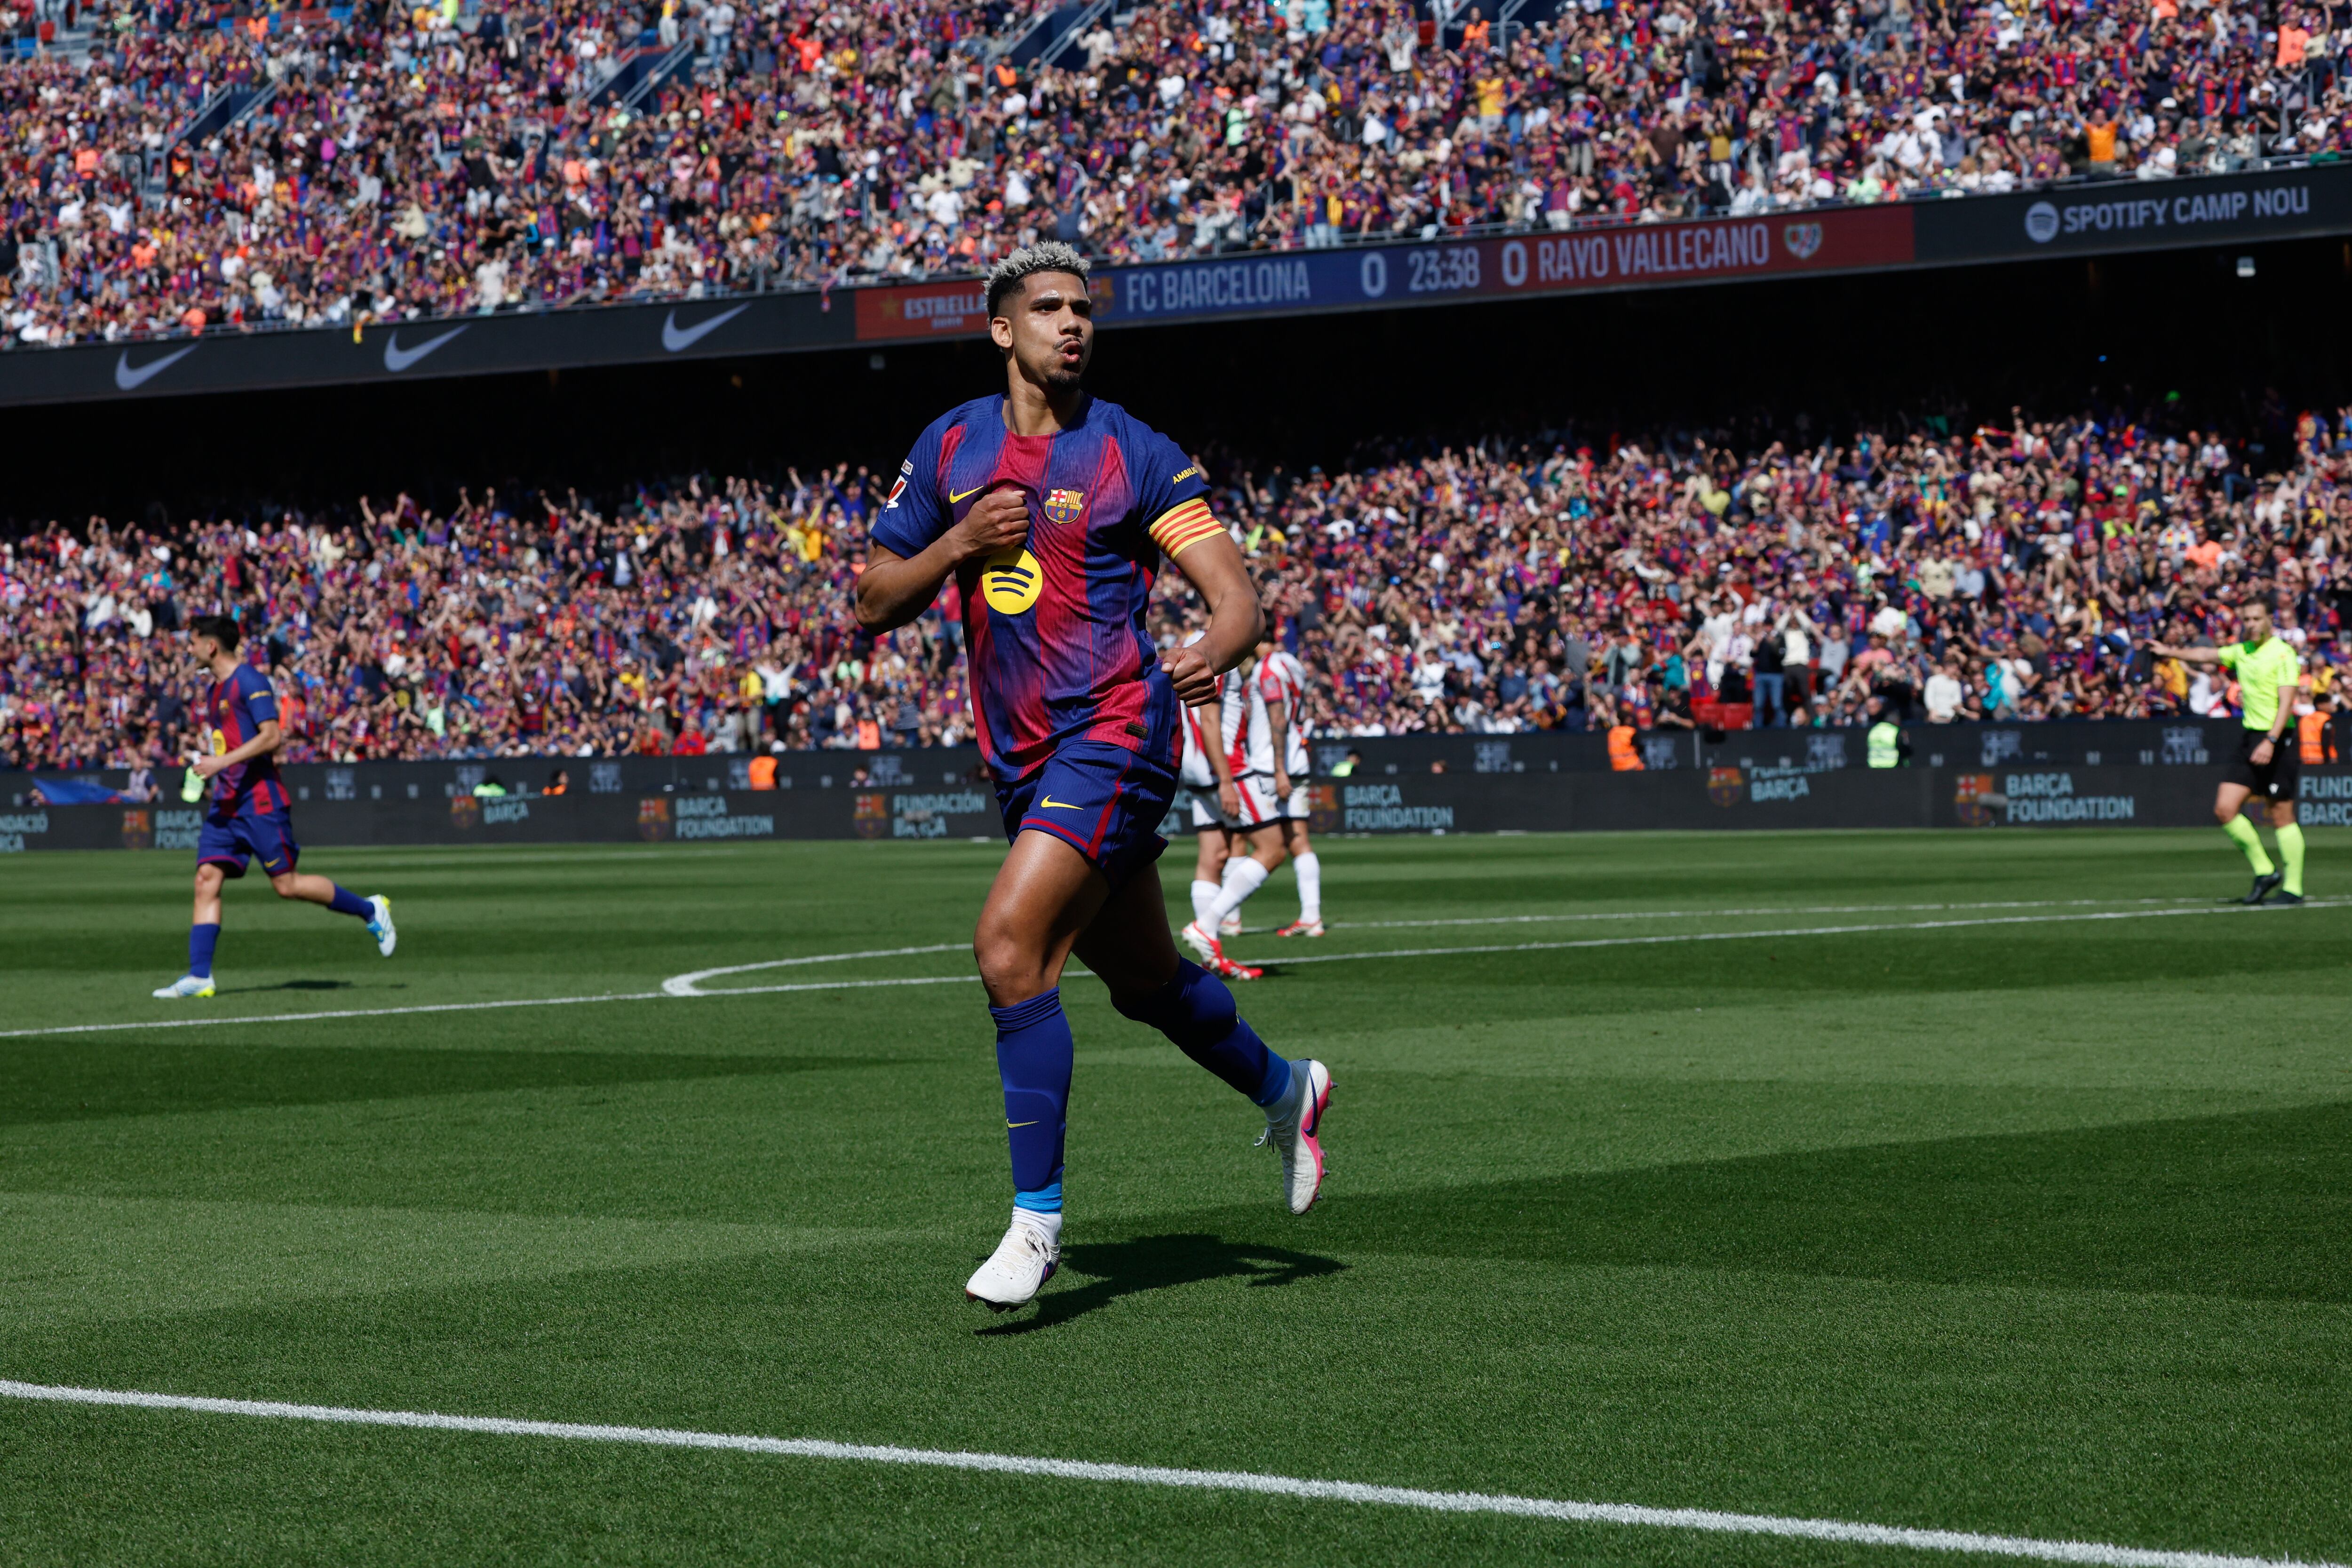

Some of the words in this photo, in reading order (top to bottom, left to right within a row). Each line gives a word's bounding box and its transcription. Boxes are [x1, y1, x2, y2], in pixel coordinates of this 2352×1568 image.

[2064, 198, 2168, 233] SPOTIFY
[2173, 191, 2247, 223] CAMP
[2254, 186, 2310, 217] NOU
[1127, 271, 1157, 312] FC
[1162, 261, 1311, 310] BARCELONA
[1360, 252, 1387, 297] 0
[1408, 246, 1481, 292] 23:38
[1502, 240, 1528, 286] 0
[1537, 236, 1609, 282] RAYO
[1614, 223, 1770, 276] VALLECANO
[1344, 785, 1402, 807] BARÇA
[1751, 776, 1810, 803] BARÇA
[2006, 772, 2074, 799] BARÇA
[484, 801, 529, 825] BARÇA
[675, 796, 727, 817] BARÇA
[893, 788, 986, 814] FUNDACIÓN
[2006, 796, 2134, 822] FOUNDATION
[155, 810, 202, 830] BARÇA
[675, 815, 773, 839] FOUNDATION
[1344, 806, 1454, 830] FOUNDATION
